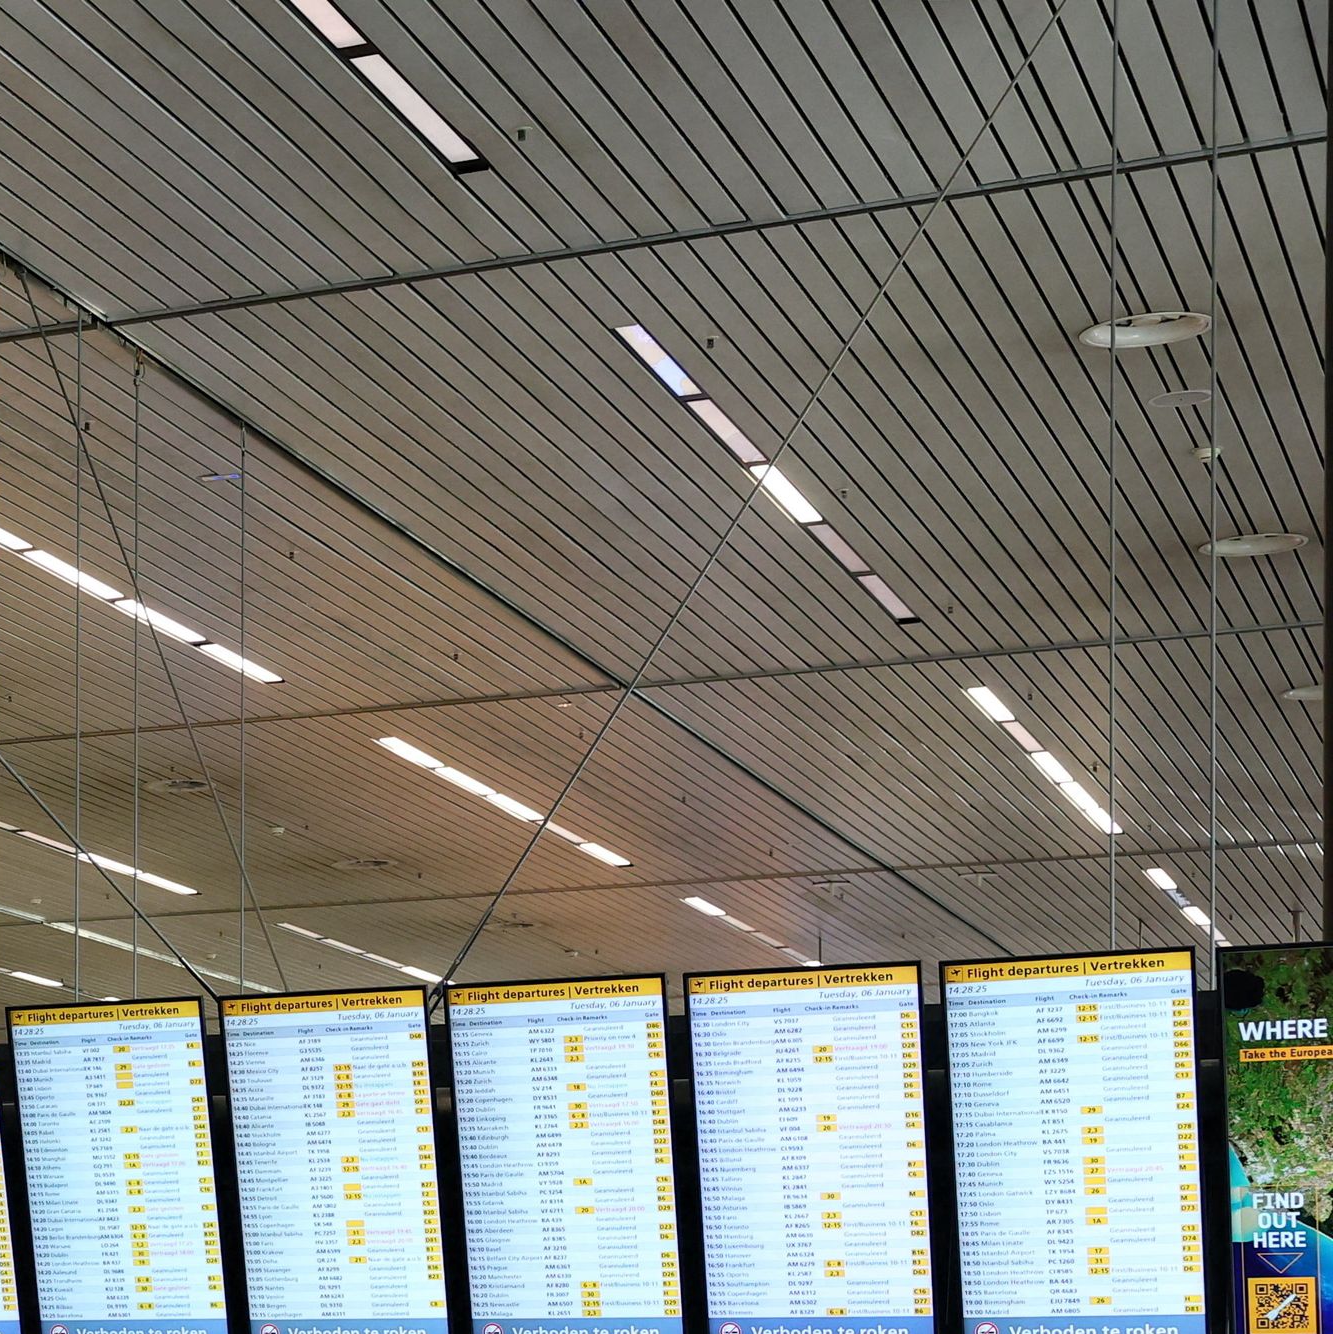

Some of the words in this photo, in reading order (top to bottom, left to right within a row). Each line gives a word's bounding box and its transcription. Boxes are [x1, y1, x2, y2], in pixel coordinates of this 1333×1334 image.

[967, 967, 1004, 980] Flight
[1009, 963, 1079, 978] departures
[1091, 959, 1164, 971] Vertrekken
[709, 980, 743, 991] Flight
[748, 977, 813, 990] departures
[824, 973, 892, 984] Vertrekken
[1131, 977, 1141, 985] 06
[1143, 974, 1184, 984] January
[467, 991, 499, 1002] Flight
[503, 988, 565, 1000] departures
[575, 984, 639, 995] Vertrekken
[861, 989, 871, 997] 06
[873, 987, 911, 996] January
[969, 998, 1006, 1006] Destination
[1036, 995, 1054, 1003] Flight
[241, 1002, 271, 1014] Flight
[275, 999, 333, 1011] departures
[341, 996, 402, 1007] Vertrekken
[621, 999, 656, 1008] January
[28, 1013, 57, 1024] Flight
[60, 1010, 114, 1021] departures
[122, 1007, 179, 1017] Vertrekken
[386, 1010, 418, 1018] January
[1239, 1019, 1328, 1041] WHERE
[1242, 1050, 1266, 1059] Take
[1270, 1049, 1286, 1058] the
[1253, 1192, 1304, 1209] FIND
[1259, 1212, 1301, 1229] OUT
[1253, 1232, 1306, 1248] HERE
